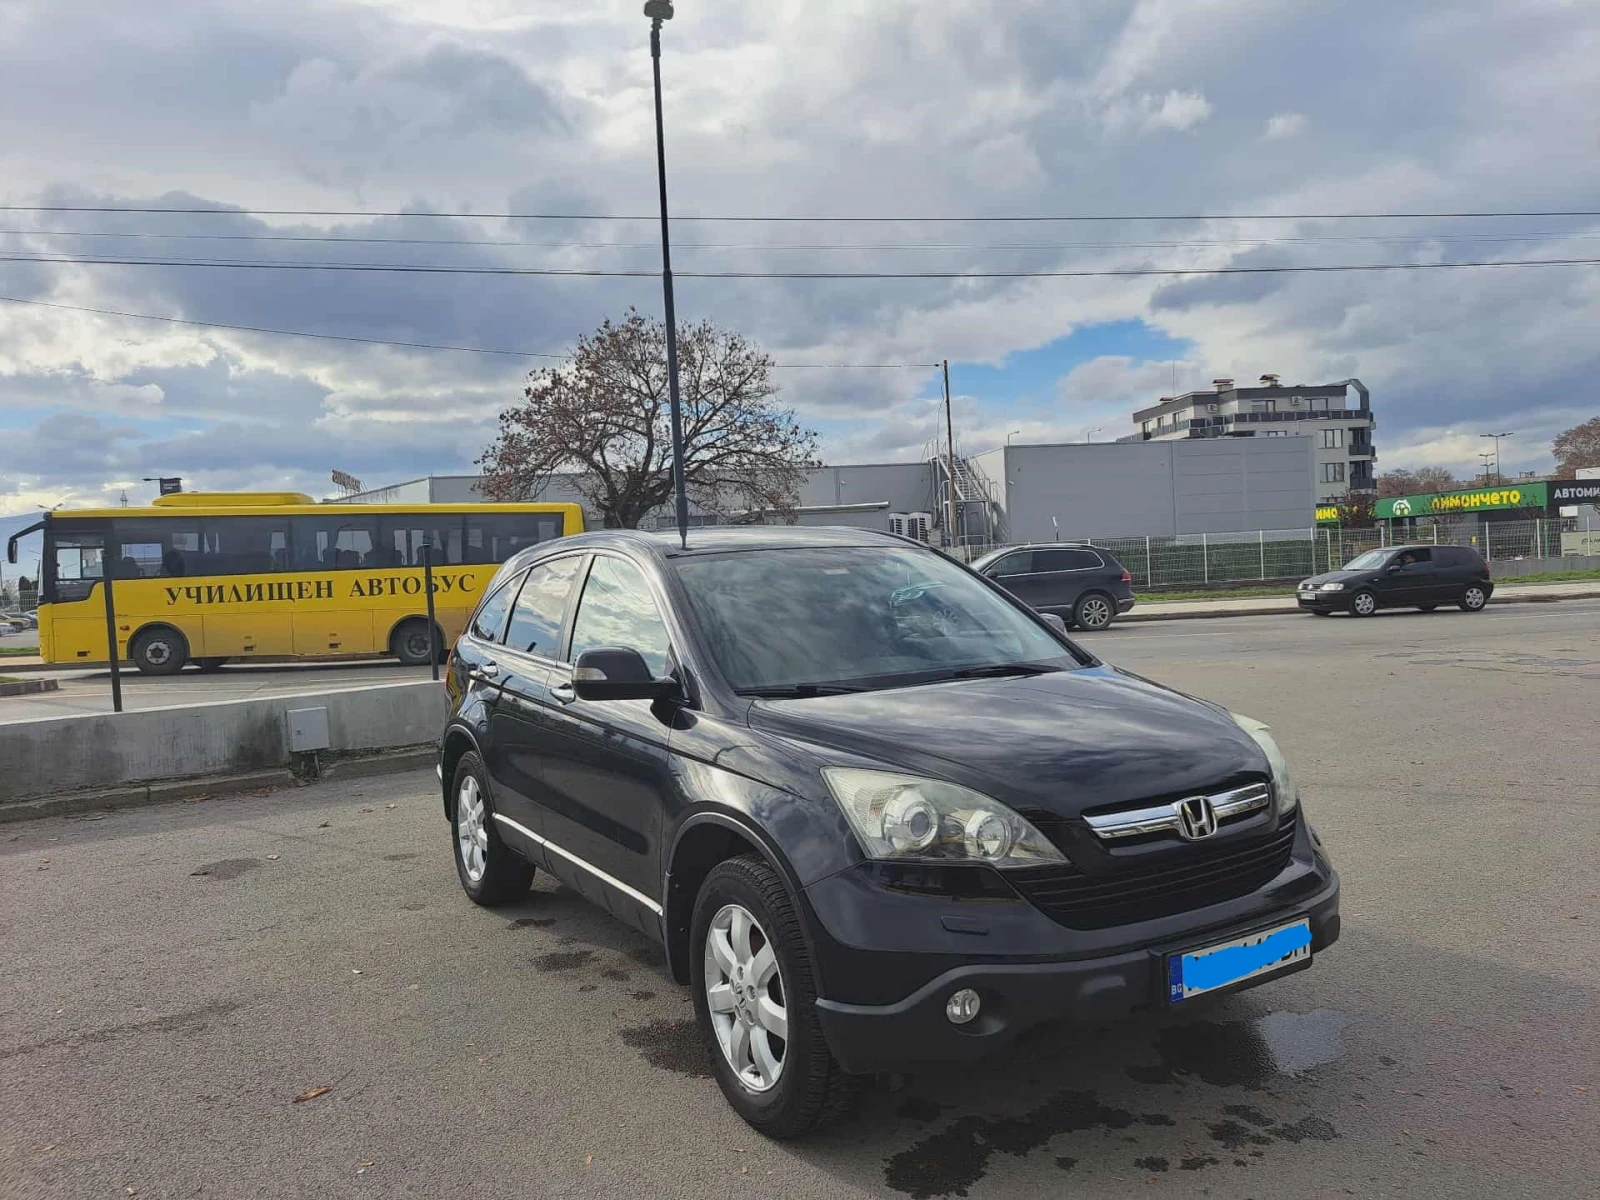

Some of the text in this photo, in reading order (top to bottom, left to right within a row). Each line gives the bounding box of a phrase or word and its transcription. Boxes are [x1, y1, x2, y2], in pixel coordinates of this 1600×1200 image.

[164, 573, 476, 606] УЧИЛИЩЕН АВТОБУС
[1171, 983, 1183, 995] BG
